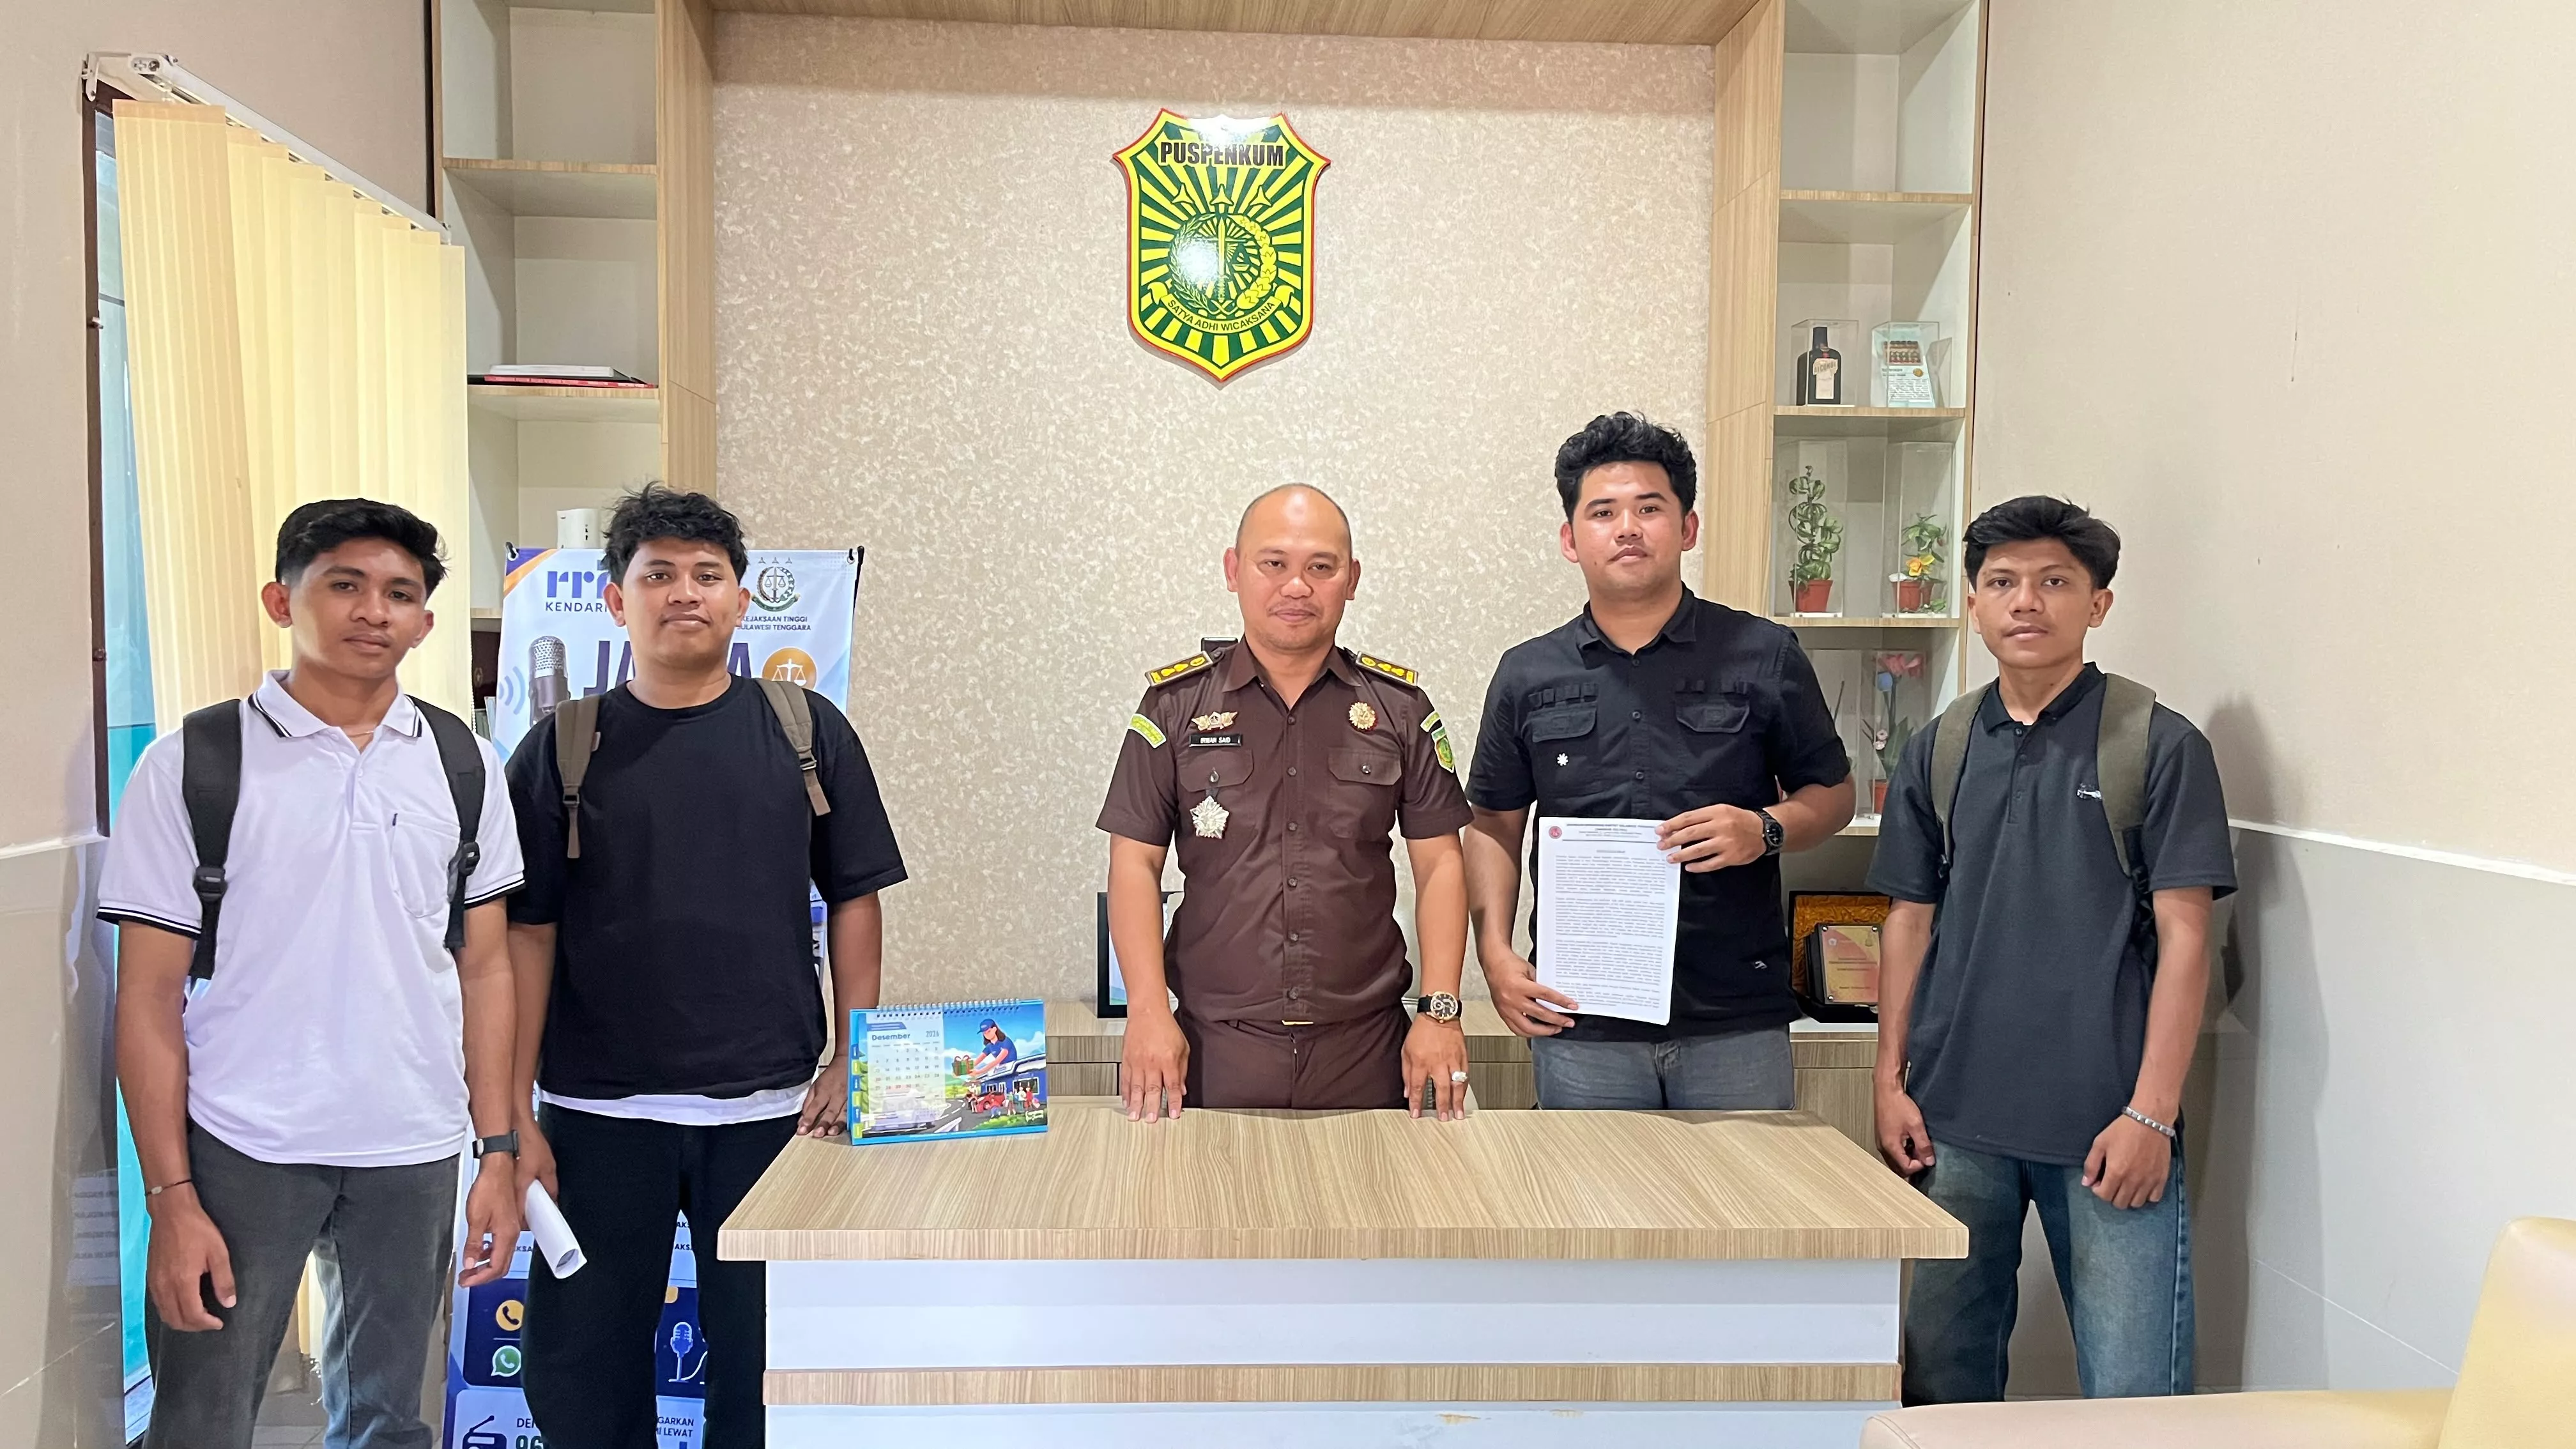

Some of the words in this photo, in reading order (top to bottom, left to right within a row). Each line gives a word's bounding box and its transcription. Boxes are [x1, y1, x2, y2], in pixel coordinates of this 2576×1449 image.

[1161, 142, 1284, 166] PUSPENKUM
[1168, 300, 1193, 324] SATYA
[1194, 319, 1218, 331] ADHI
[1221, 302, 1275, 331] WICAKSANA
[664, 1427, 693, 1438] LEWAT
